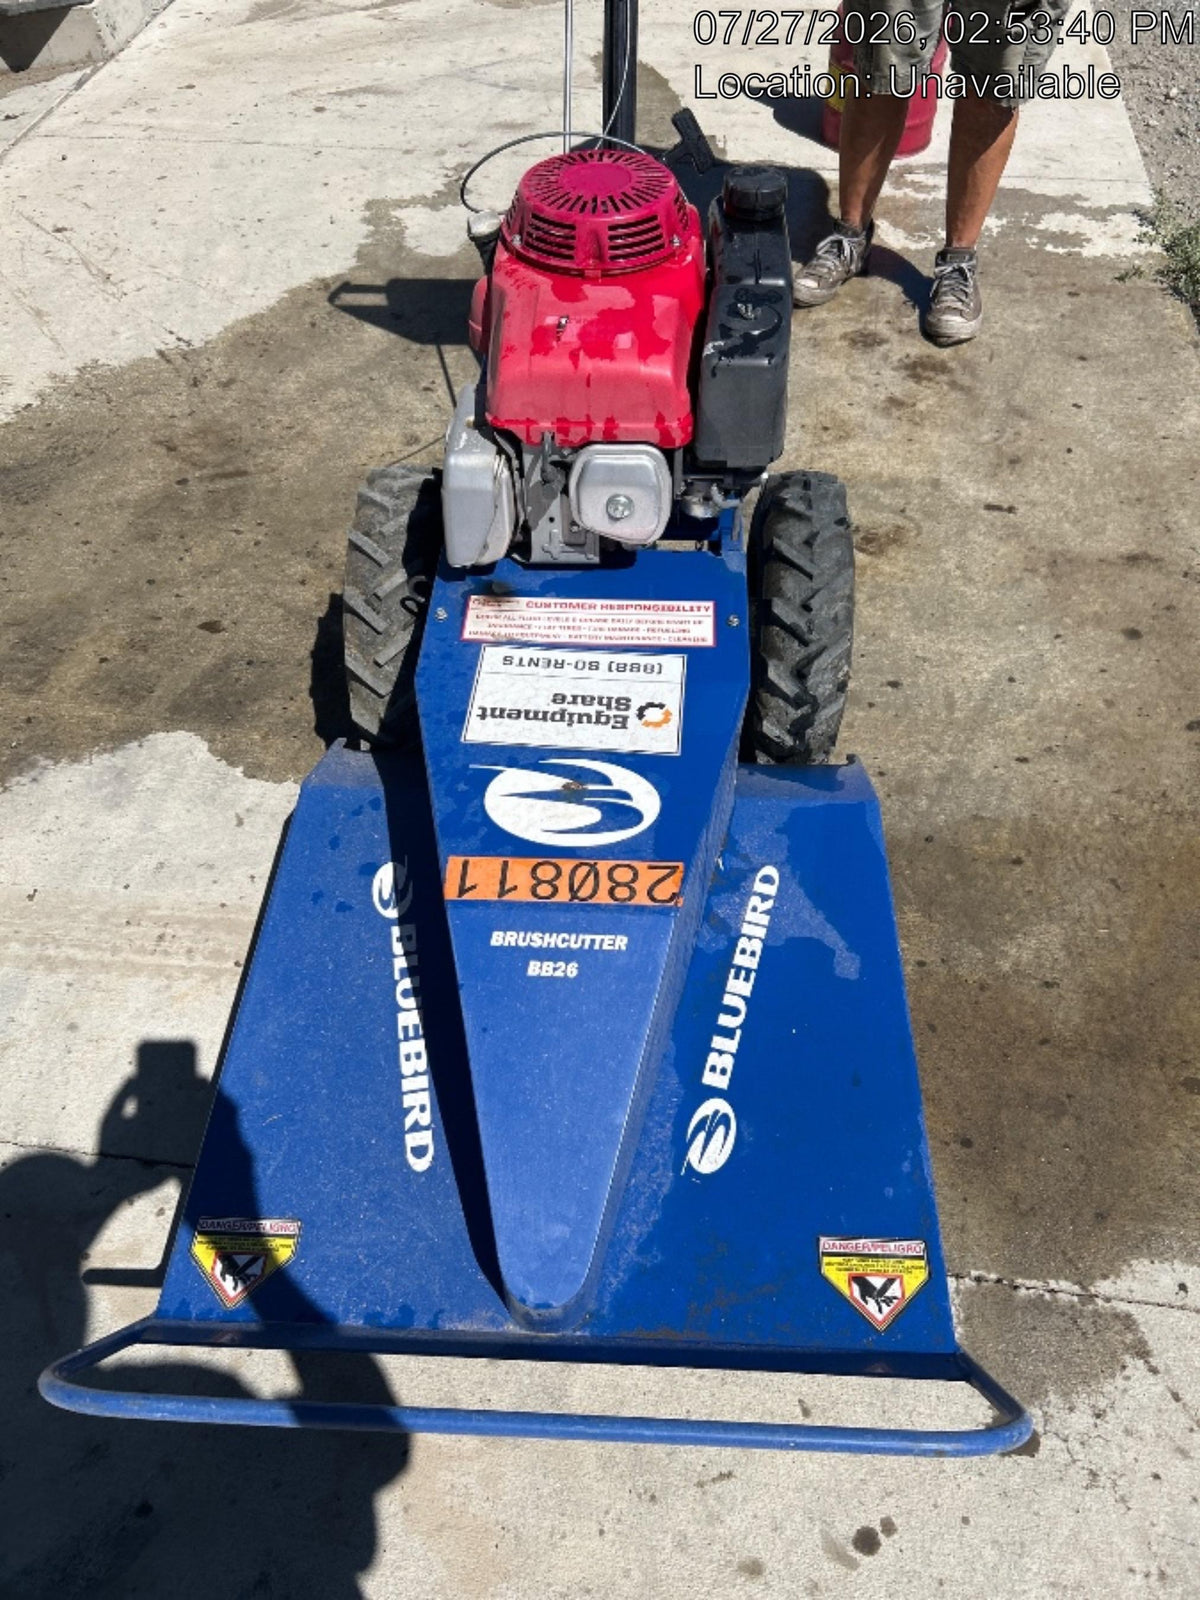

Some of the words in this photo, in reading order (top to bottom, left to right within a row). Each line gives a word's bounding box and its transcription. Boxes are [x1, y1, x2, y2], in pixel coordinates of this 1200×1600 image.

[525, 600, 597, 610] CUSTOMER
[600, 603, 711, 613] RESPONSIBILITY
[551, 692, 632, 711] Share
[476, 706, 630, 730] Equipment
[490, 931, 628, 951] BRUSHCUTTER
[526, 960, 579, 978] BB26
[701, 865, 780, 1090] BLUEBIRD
[390, 924, 434, 1172] BLUEBIRD
